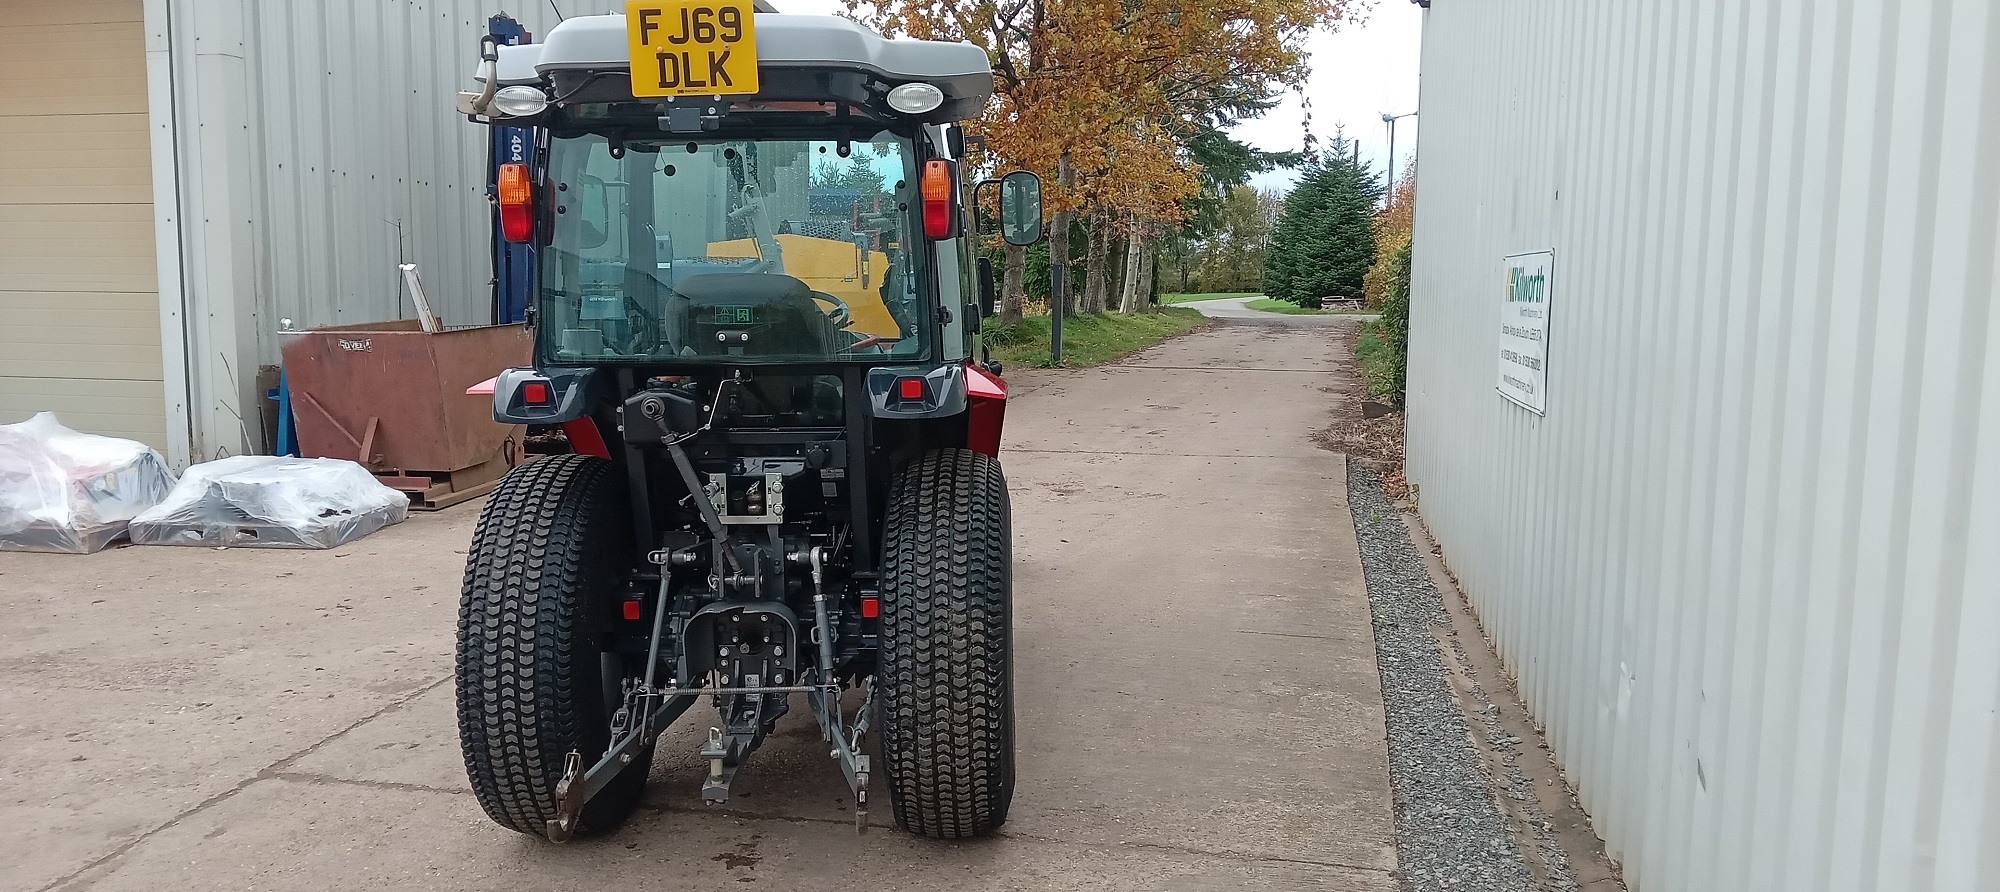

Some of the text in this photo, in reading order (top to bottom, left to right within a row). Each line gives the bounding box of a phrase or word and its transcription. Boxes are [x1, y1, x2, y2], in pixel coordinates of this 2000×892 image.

[639, 6, 742, 46] FJ69
[656, 50, 733, 89] DLK
[1515, 265, 1545, 303] Kilworth
